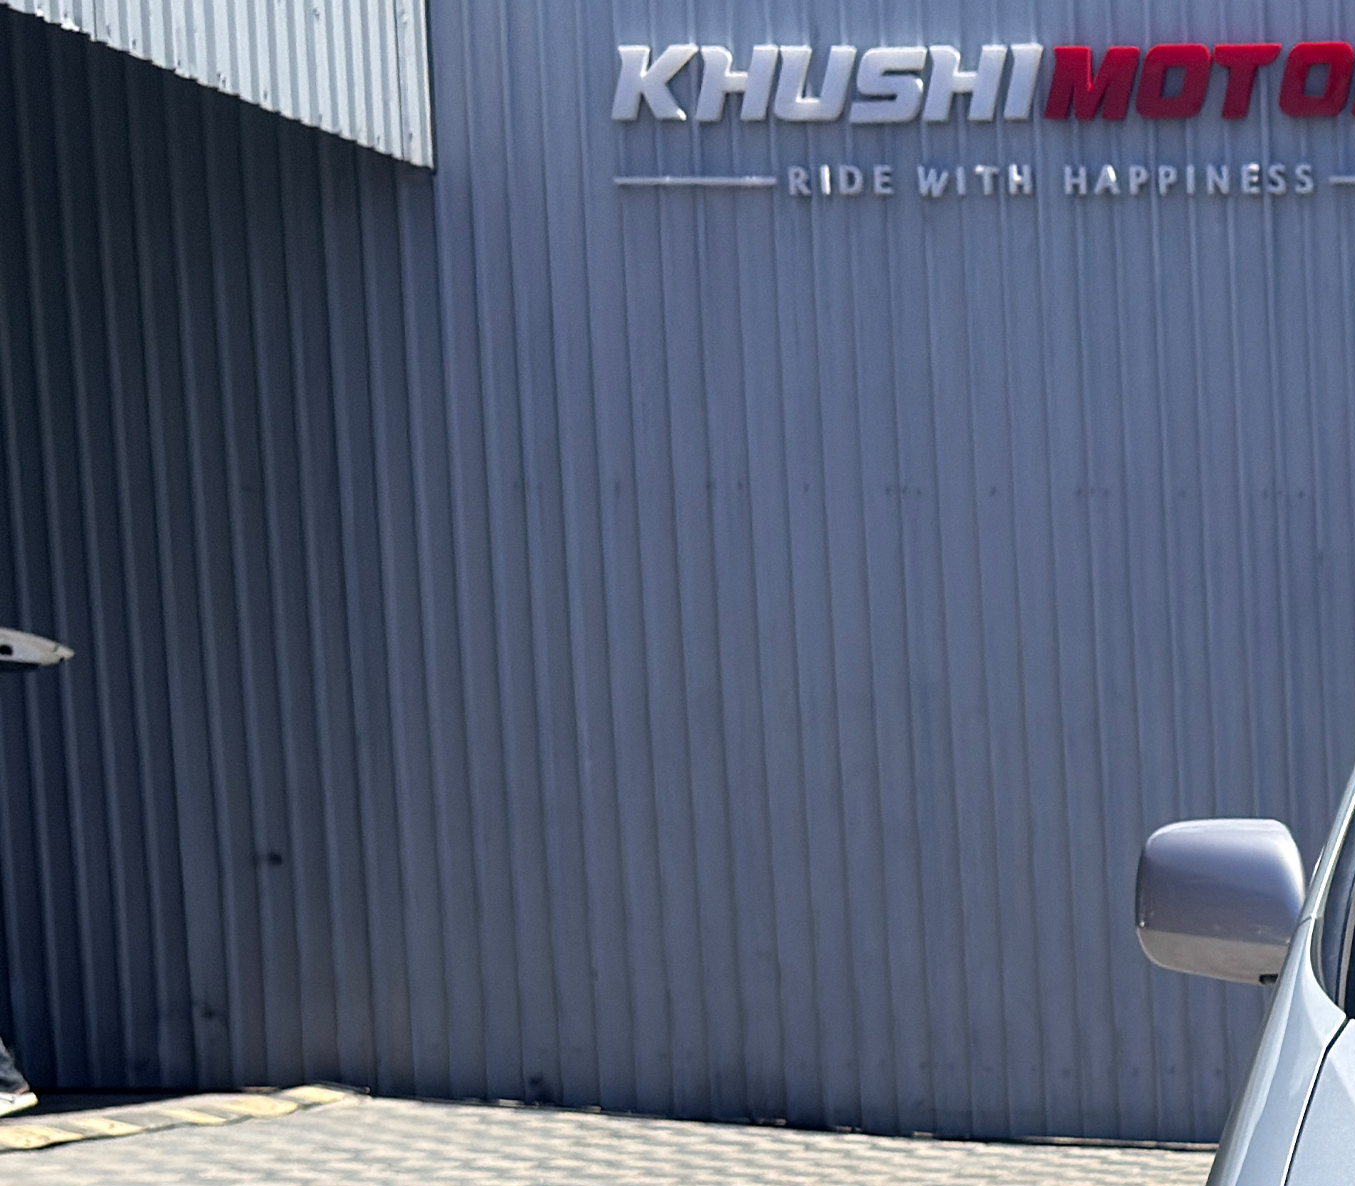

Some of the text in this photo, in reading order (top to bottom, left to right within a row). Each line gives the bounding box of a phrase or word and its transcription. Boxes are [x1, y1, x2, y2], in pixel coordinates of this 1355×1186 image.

[787, 163, 1315, 197] RIDE WITH HAPPINESS
